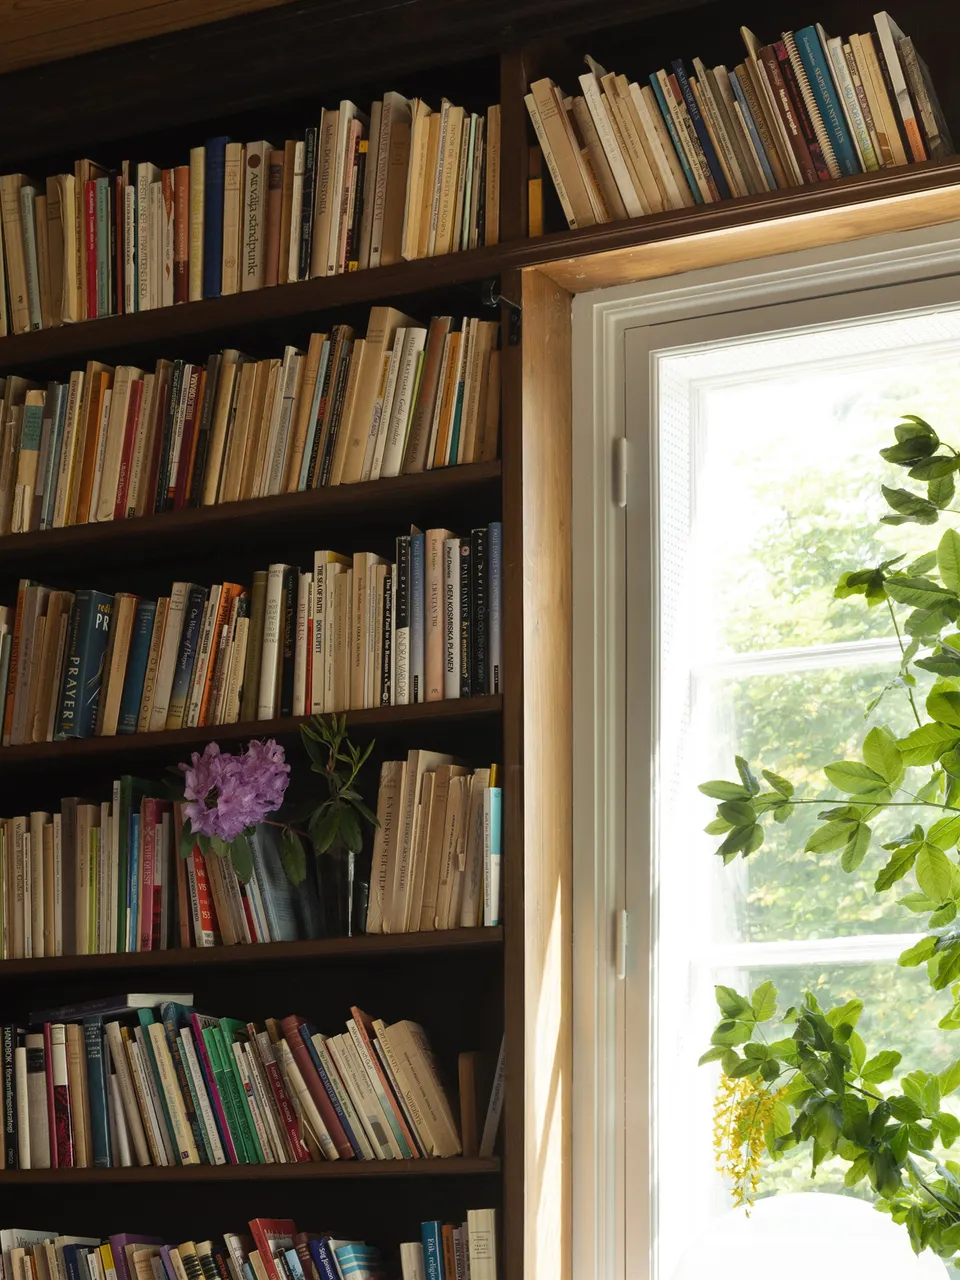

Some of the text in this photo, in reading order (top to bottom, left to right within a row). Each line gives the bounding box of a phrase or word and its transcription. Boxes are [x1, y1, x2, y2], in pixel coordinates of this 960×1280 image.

[675, 66, 693, 103] SKAPANDE
[689, 102, 700, 120] PAUS
[778, 87, 798, 136] Mellan speglar
[813, 66, 844, 143] SKAPELSEN NYTT LJUS
[843, 84, 863, 130] VAD TROR DU
[374, 102, 390, 221] VISIONÄRER, VISMÄN OCH VI
[447, 148, 453, 158] DE
[318, 149, 331, 215] DOGMHISTORIA
[443, 161, 452, 198] YTTERSTA
[246, 171, 258, 276] Att välja ståndpunkt
[439, 200, 450, 238] FRÅGORNA
[185, 372, 198, 419] BIBLIODRAMA
[397, 336, 415, 415] HELGE BRATTGÅRD Goda
[66, 398, 74, 428] BERGGRAV
[9, 636, 20, 674] KRISTENS
[179, 607, 198, 670] On Wings of Prayer
[201, 629, 210, 654] QUESTIONS
[397, 631, 406, 662] ANDRA
[62, 655, 80, 719] PRAYER
[138, 619, 163, 728] Chesterton ORTODOXI
[397, 664, 407, 698] VÄRLDAR
[15, 823, 23, 848] Walther
[380, 796, 393, 866] EN BISKOP SER
[15, 874, 23, 891] Guds
[350, 1025, 373, 1070] Människan och Gud
[376, 1026, 389, 1046] GRETA
[4, 1067, 13, 1133] församlingsstrategi
[270, 1065, 278, 1080] ARMY
[281, 1101, 292, 1123] CHURCH
[215, 1252, 229, 1278] BRITAIN
[316, 1246, 327, 1259] Stig
[427, 1237, 435, 1254] Etik,
[320, 1257, 335, 1280] Jonsson
